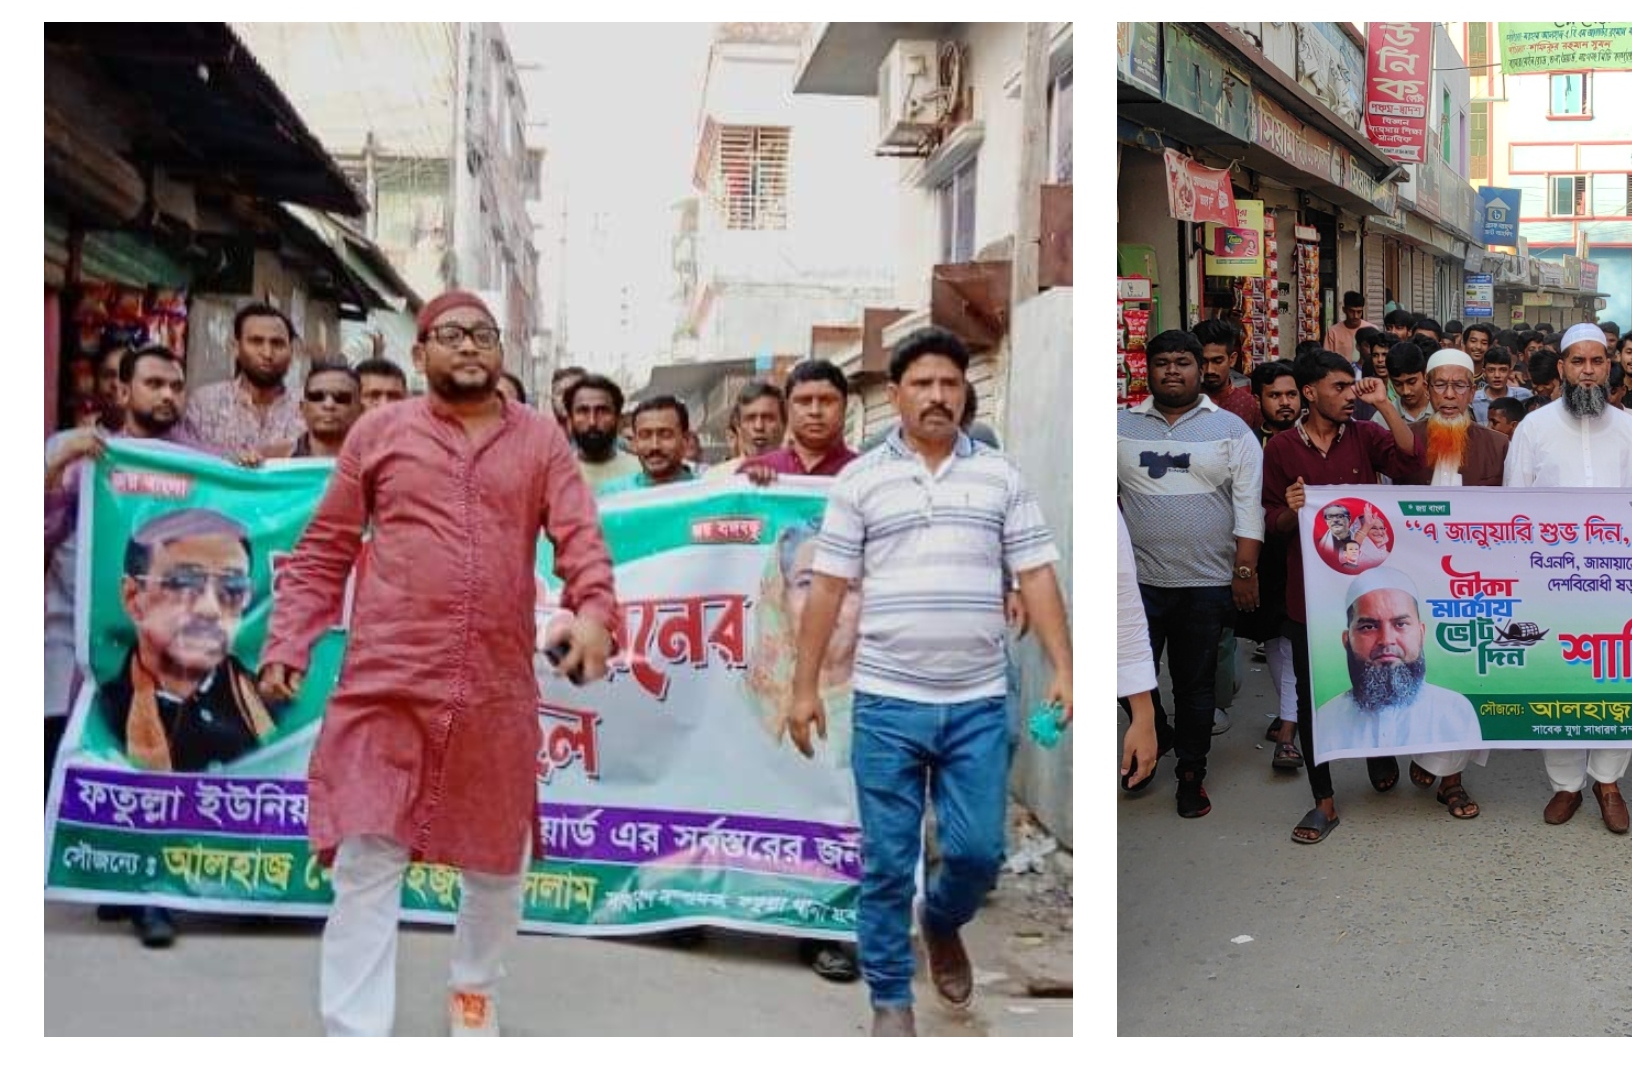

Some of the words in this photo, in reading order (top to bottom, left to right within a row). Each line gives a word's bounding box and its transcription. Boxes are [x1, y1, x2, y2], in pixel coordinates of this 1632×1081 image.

[1444, 514, 1534, 546] জানুয়ারি
[1539, 521, 1578, 544] শুভ
[1584, 514, 1631, 546] দিন,
[1530, 551, 1580, 571] বিএনপি,
[1441, 555, 1519, 599] নৌকা
[1548, 574, 1611, 592] দেশবিরোধী
[1426, 592, 1522, 622] মার্কায়
[1436, 615, 1496, 653] ভোট
[1478, 642, 1525, 675] দিন
[1528, 699, 1632, 724] আলহাজ্ব
[1532, 724, 1562, 737] সাবেক
[1584, 723, 1618, 737] সাধারণ
[75, 778, 185, 827] ফতুল্লা
[610, 822, 661, 854] এর
[671, 816, 805, 864] সর্বস্তরের
